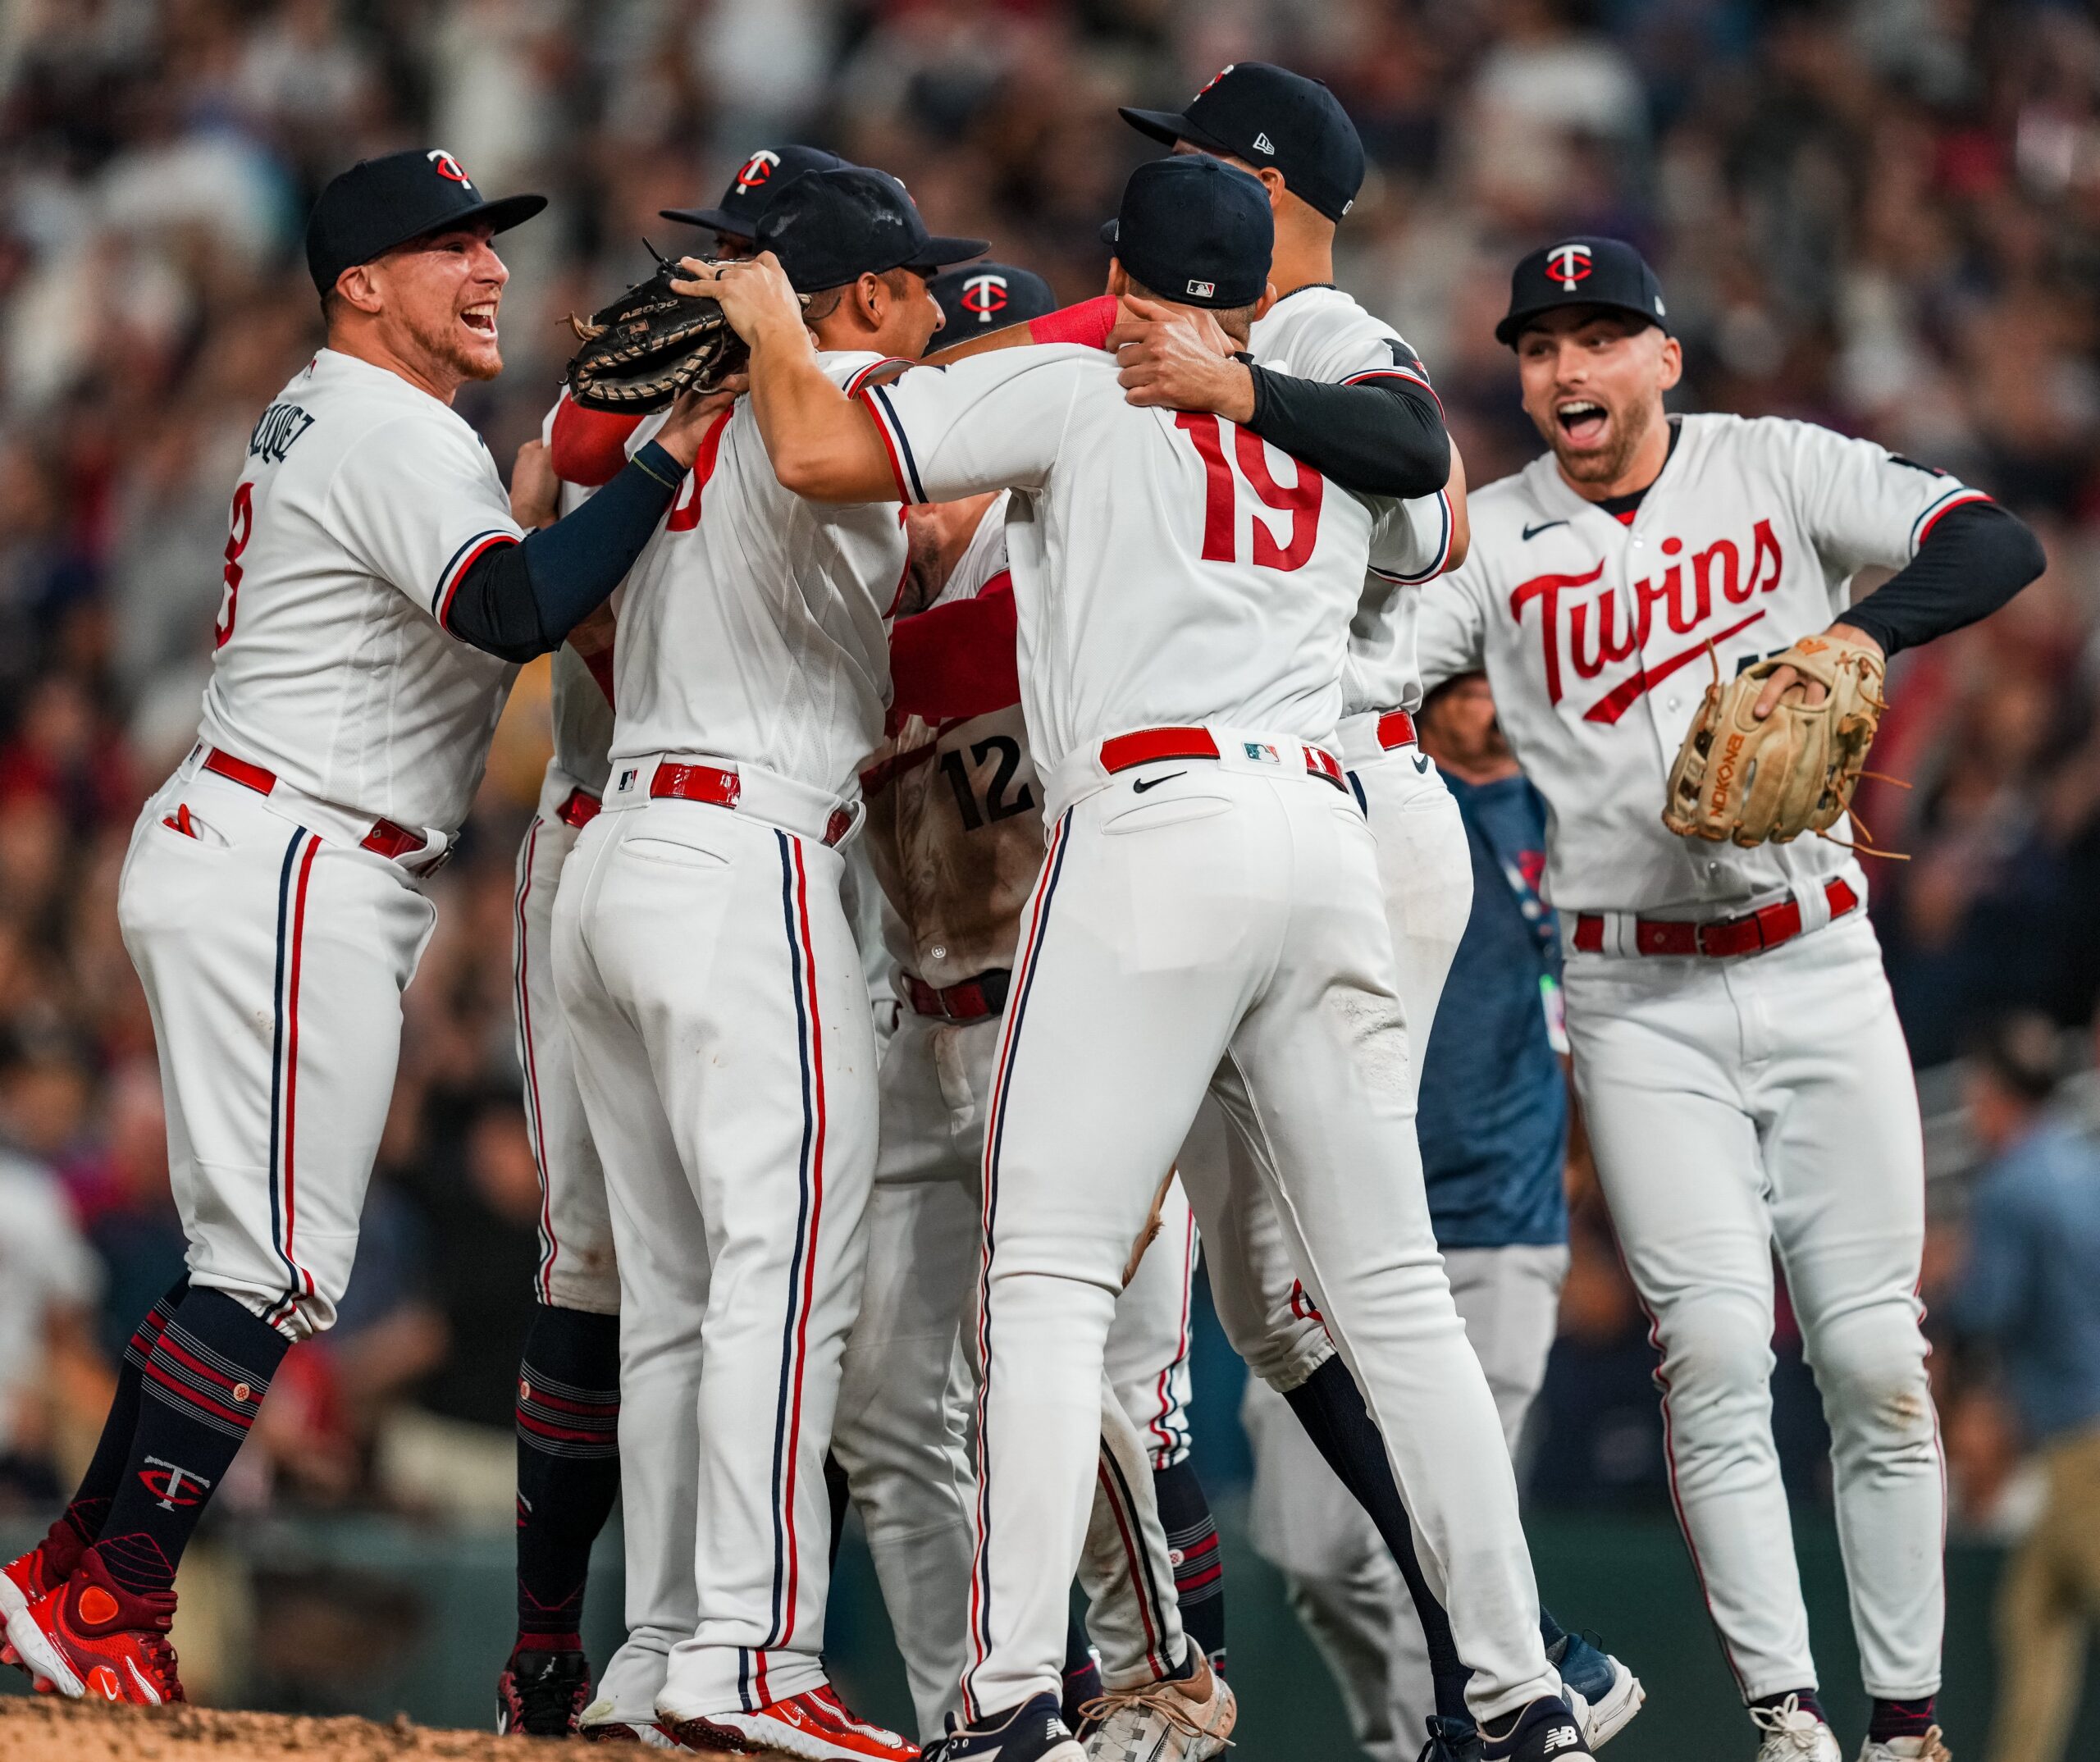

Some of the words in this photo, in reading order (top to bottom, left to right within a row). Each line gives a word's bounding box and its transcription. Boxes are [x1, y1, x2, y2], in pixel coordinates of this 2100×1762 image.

[1175, 411, 1323, 573] 19
[1509, 518, 1783, 709] Twins
[939, 735, 1035, 832] 12
[1710, 733, 1746, 818] NOKONA
